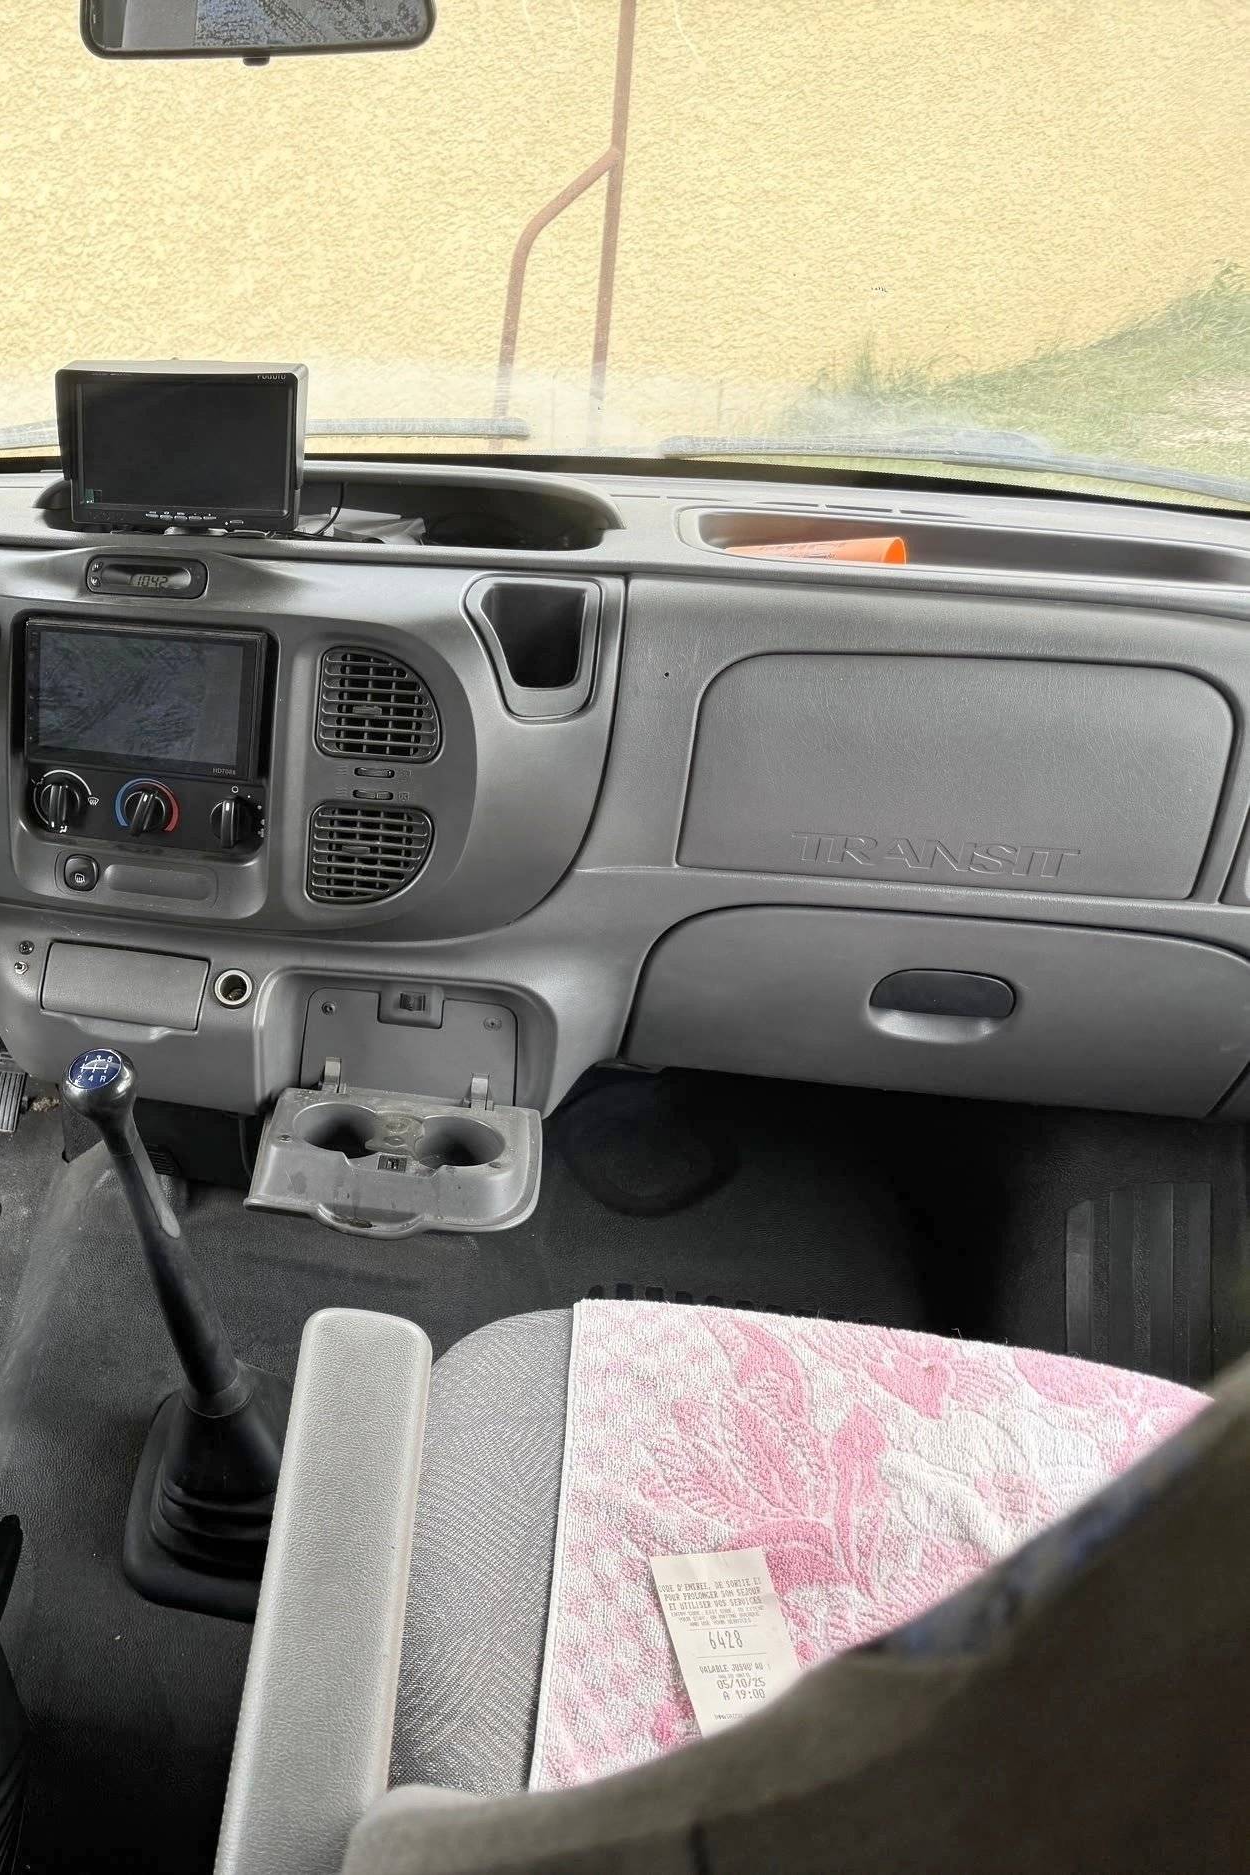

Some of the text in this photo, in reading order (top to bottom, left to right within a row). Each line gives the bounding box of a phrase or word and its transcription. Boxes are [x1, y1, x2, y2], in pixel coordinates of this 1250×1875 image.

[791, 831, 1082, 879] TRANSIT
[708, 1629, 744, 1650] 6428
[698, 1664, 729, 1674] VALABLE
[716, 1677, 766, 1690] 05/10/25
[723, 1688, 766, 1701] A 19:00
